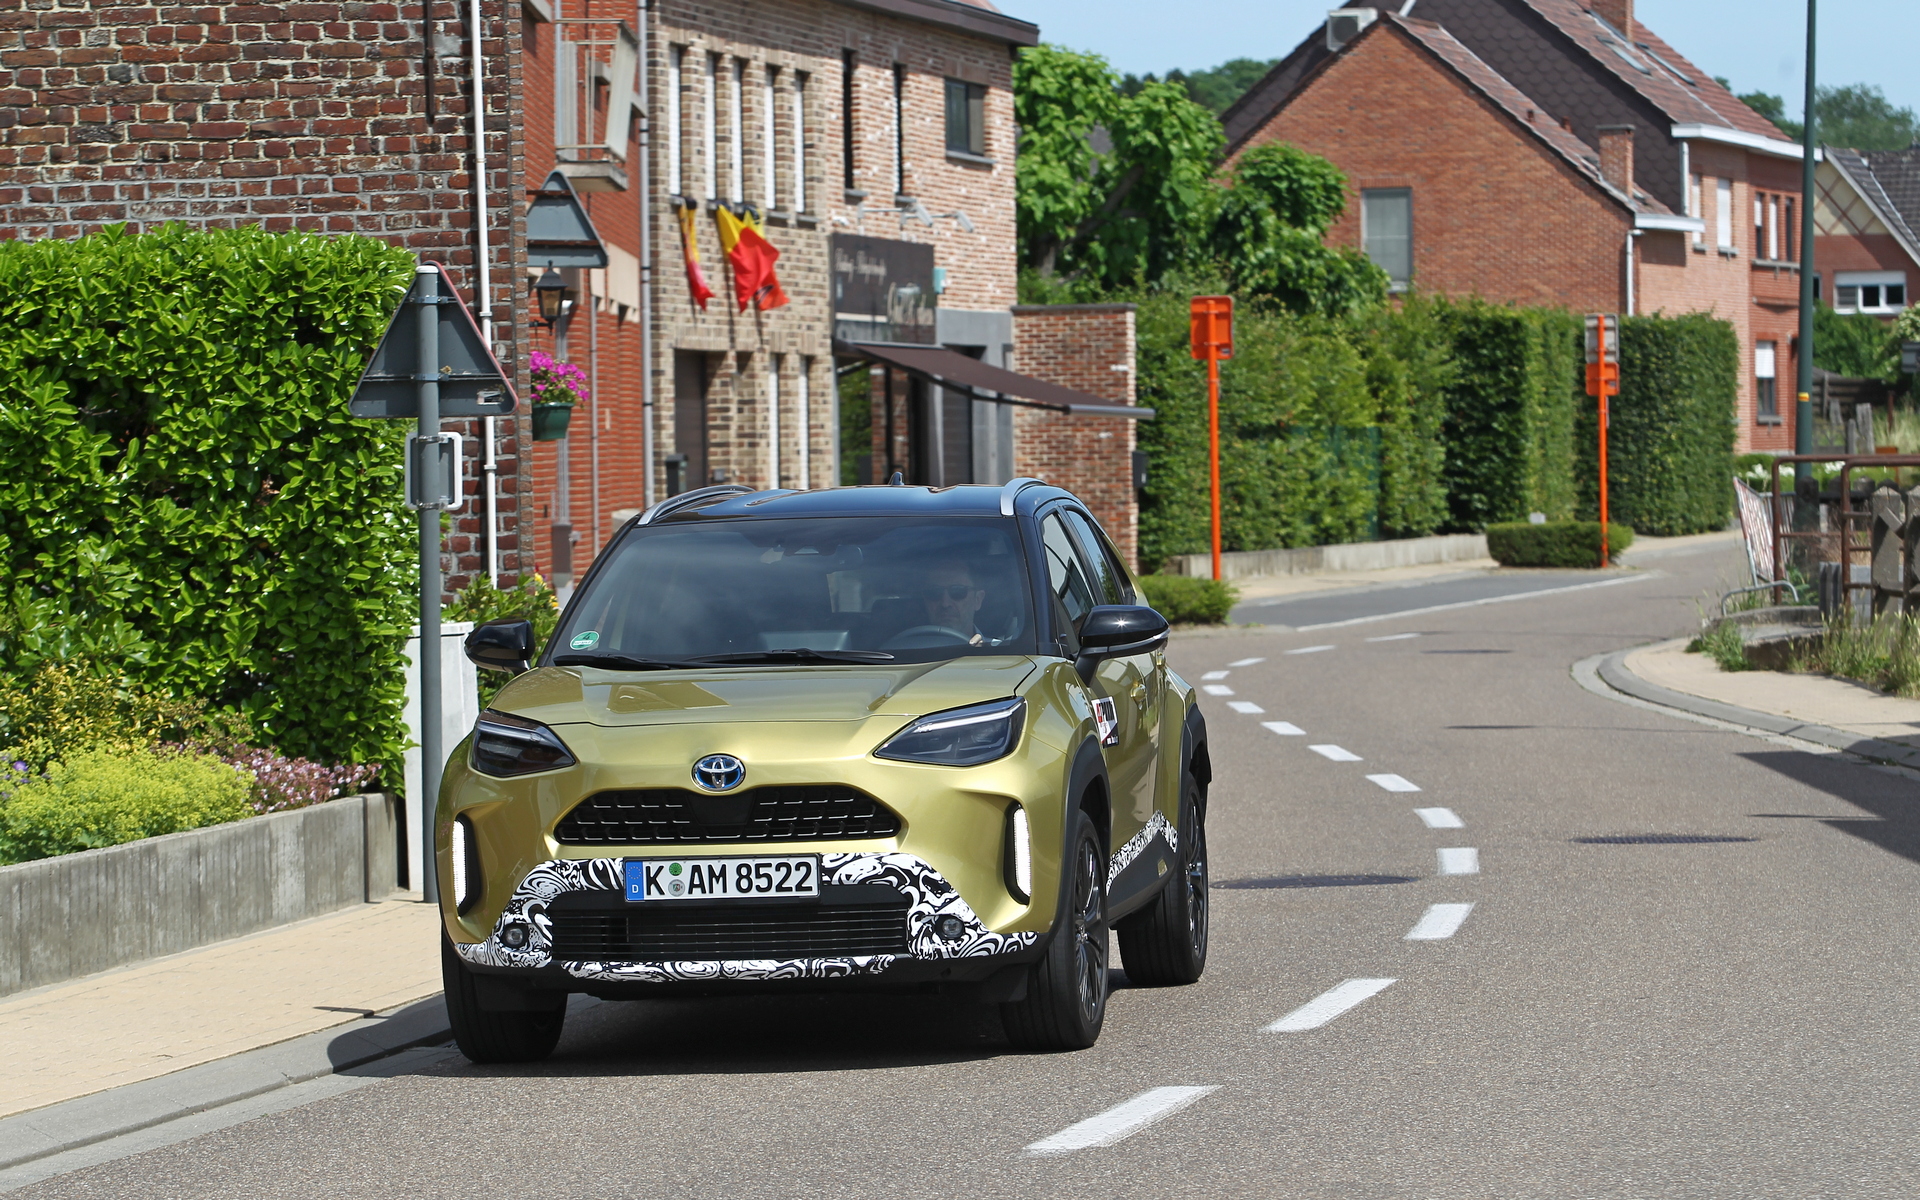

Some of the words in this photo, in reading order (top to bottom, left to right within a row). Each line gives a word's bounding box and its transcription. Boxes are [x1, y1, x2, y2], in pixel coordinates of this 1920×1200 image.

[631, 884, 639, 894] D
[645, 865, 665, 896] K
[688, 864, 728, 895] AM
[735, 861, 813, 894] 8522
